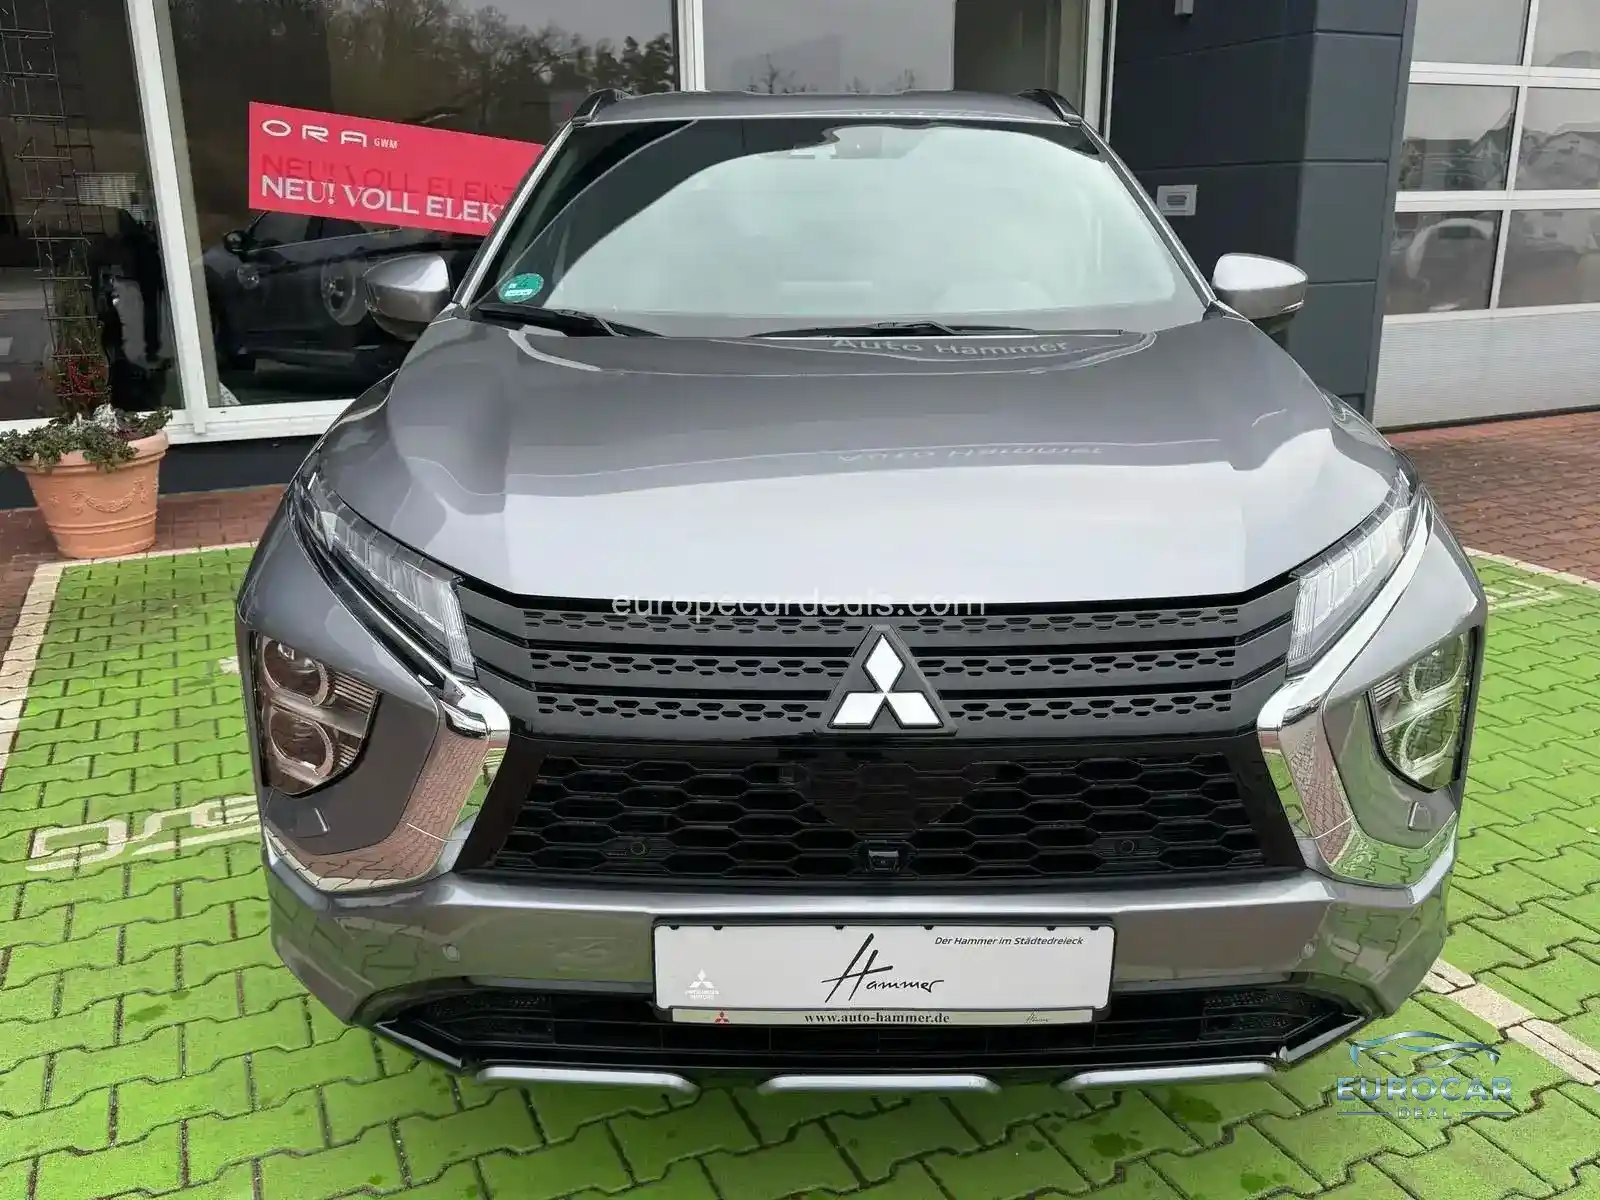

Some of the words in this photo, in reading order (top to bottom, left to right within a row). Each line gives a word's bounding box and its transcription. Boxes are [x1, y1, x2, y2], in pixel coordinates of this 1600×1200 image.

[262, 119, 367, 148] ORA
[373, 138, 399, 149] GWM
[260, 175, 335, 205] NEU!
[343, 184, 419, 215] VOLL
[425, 195, 505, 223] ELEK
[934, 936, 952, 945] Der
[953, 936, 996, 945] Hammer
[998, 936, 1012, 945] im
[1013, 935, 1084, 945] Städtedreieck
[821, 932, 945, 1003] Hammer
[804, 1012, 950, 1024] www.auto-hammer.de
